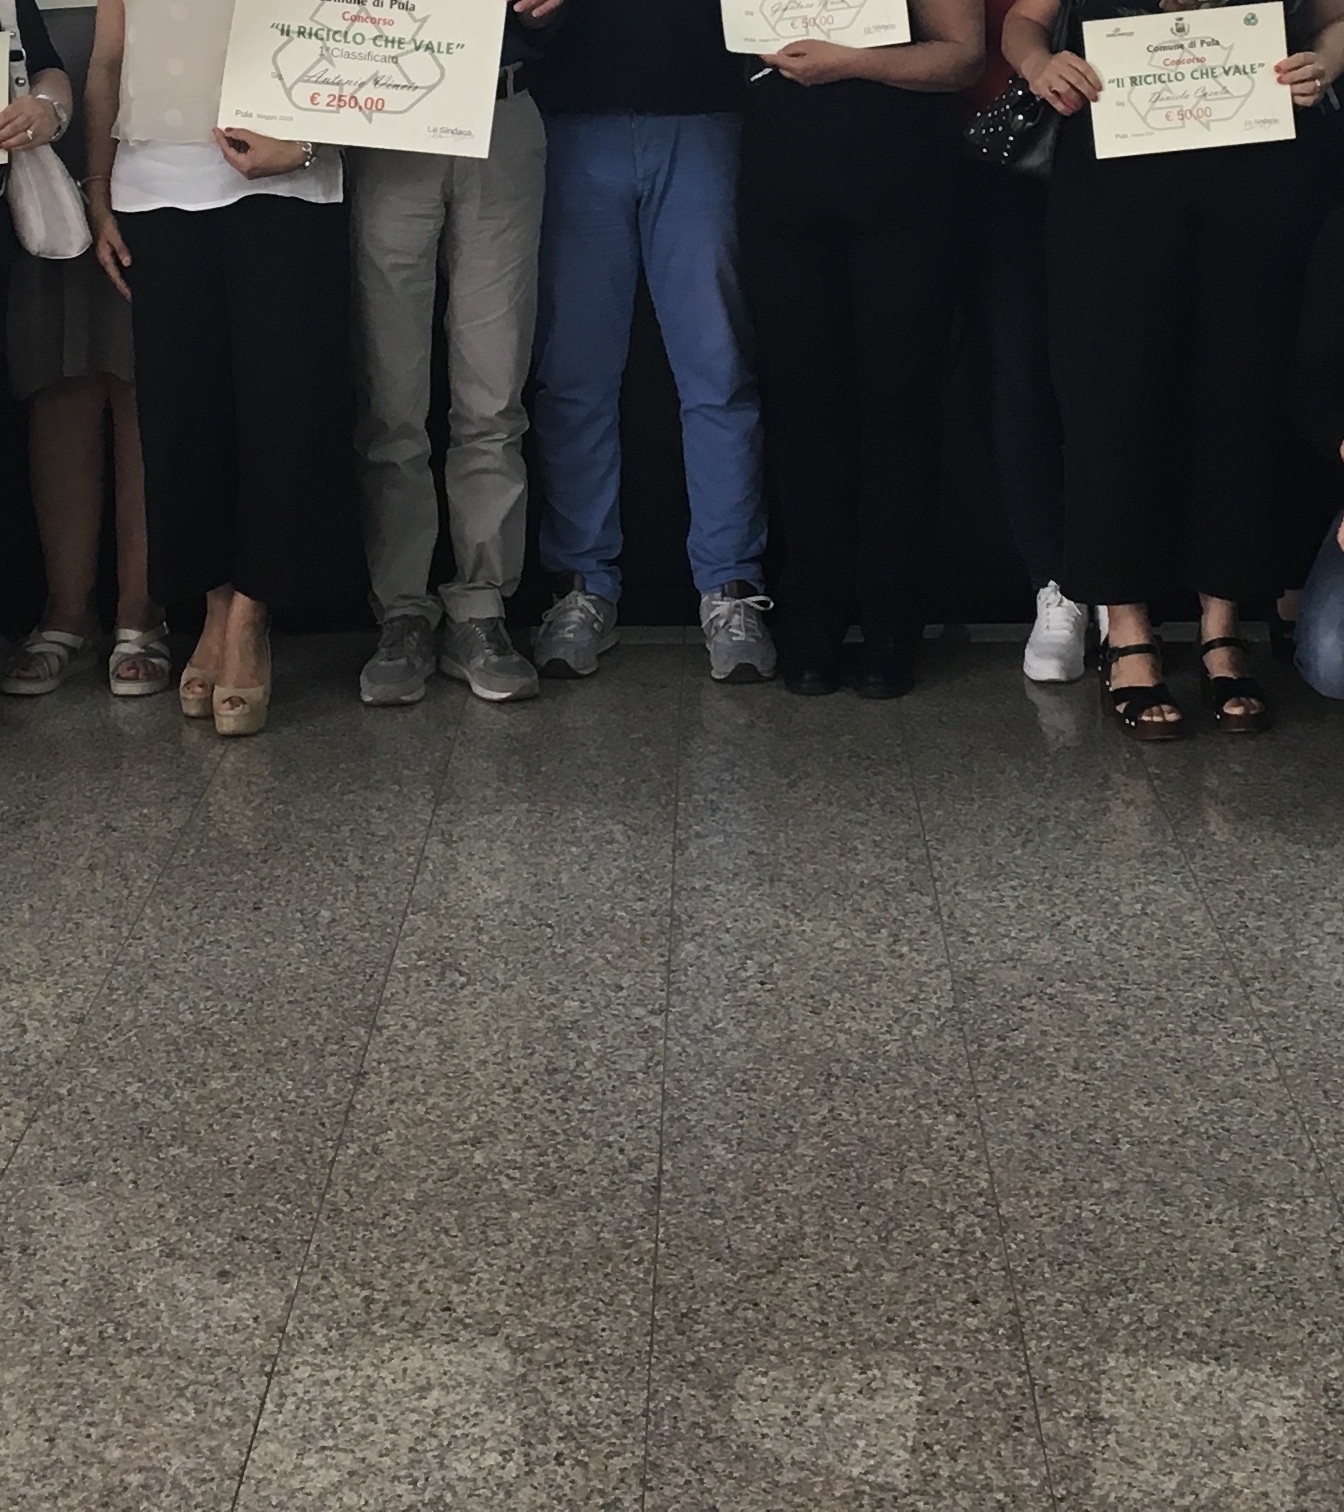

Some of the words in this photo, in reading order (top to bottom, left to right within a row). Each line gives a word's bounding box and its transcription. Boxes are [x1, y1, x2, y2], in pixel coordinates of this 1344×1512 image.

[342, 11, 395, 27] Concorso
[790, 20, 798, 29] €
[801, 14, 835, 28] 50,00
[297, 25, 366, 46] RICICLO
[372, 34, 406, 50] CHE
[414, 38, 465, 55] VALE”
[1147, 42, 1184, 53] Comune
[1188, 39, 1197, 49] di
[1200, 39, 1220, 47] Pula
[1163, 56, 1206, 67] Concorso
[306, 68, 367, 88] Antonio
[1130, 71, 1186, 87] RICICLO
[1191, 68, 1218, 80] CHE
[1223, 63, 1265, 76] VALE”
[309, 92, 321, 106] €
[325, 93, 386, 112] 250,00
[234, 109, 254, 119] Pula
[1164, 110, 1174, 121] €
[1177, 106, 1213, 121] 50,00
[427, 125, 438, 134] La
